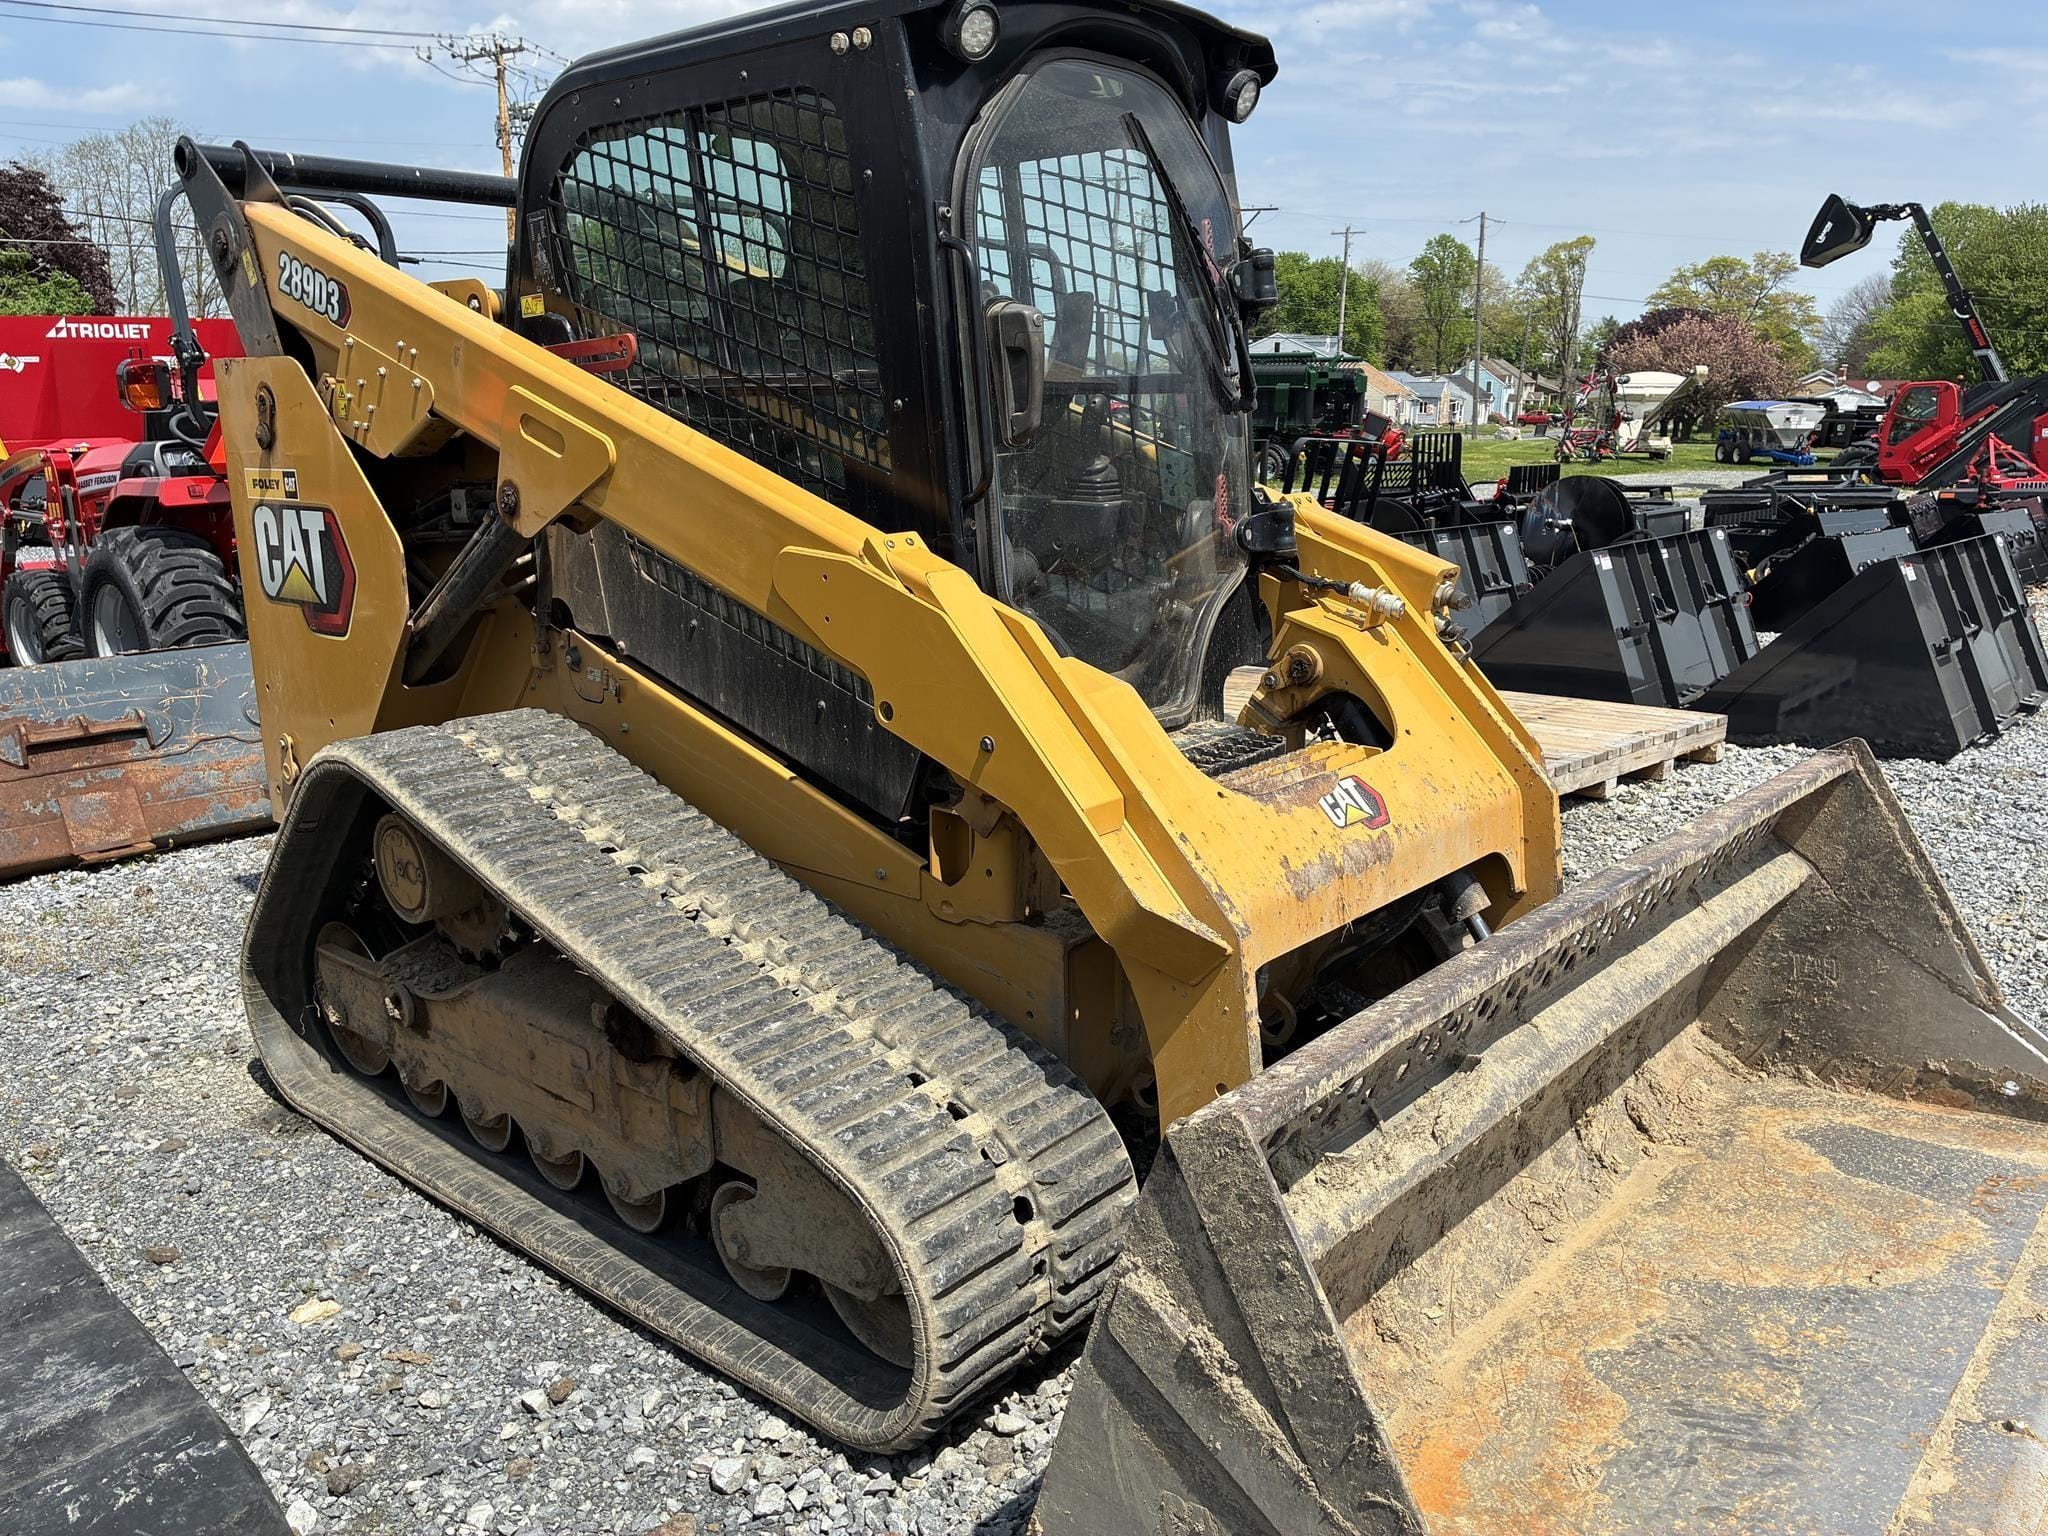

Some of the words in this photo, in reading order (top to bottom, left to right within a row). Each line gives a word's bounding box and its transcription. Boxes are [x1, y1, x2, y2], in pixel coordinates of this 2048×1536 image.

[278, 252, 340, 322] 289D3
[66, 323, 151, 339] TRIOLIET
[94, 475, 117, 486] FERGUSON
[252, 479, 280, 490] FOLEY
[284, 477, 296, 492] CAT
[254, 505, 328, 604] CAT
[1318, 777, 1375, 828] CAT
